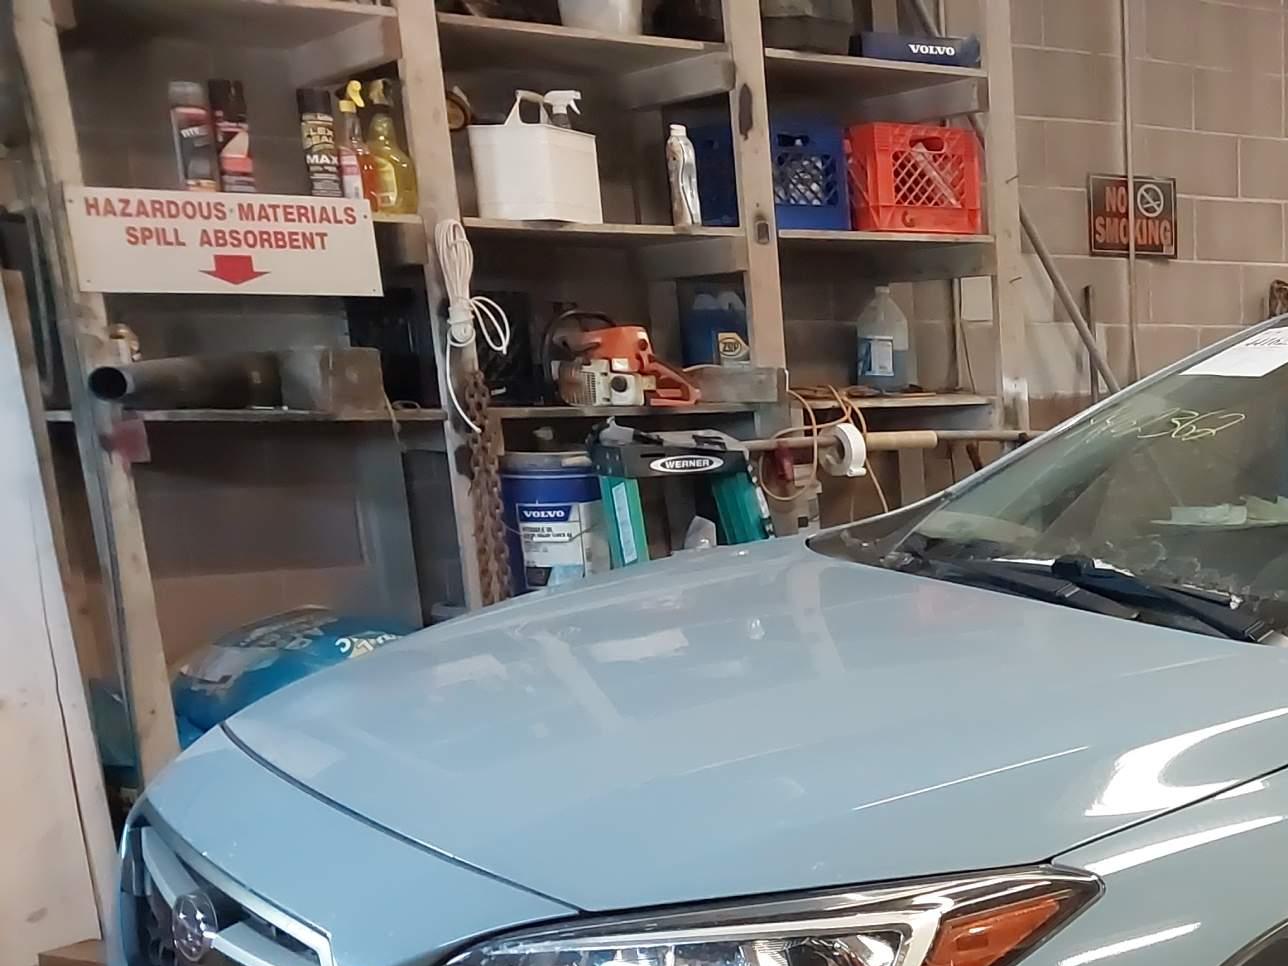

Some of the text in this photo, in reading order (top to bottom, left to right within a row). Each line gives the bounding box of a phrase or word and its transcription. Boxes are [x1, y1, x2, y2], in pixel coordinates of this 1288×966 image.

[908, 43, 956, 56] VOLVO
[306, 154, 339, 165] MAX
[1105, 186, 1128, 214] NO
[84, 196, 357, 225] HAZARDOUS MATERIALS
[125, 226, 329, 251] SPILL ABSORBENT
[664, 458, 710, 469] WERNER
[522, 510, 566, 519] VOLVO
